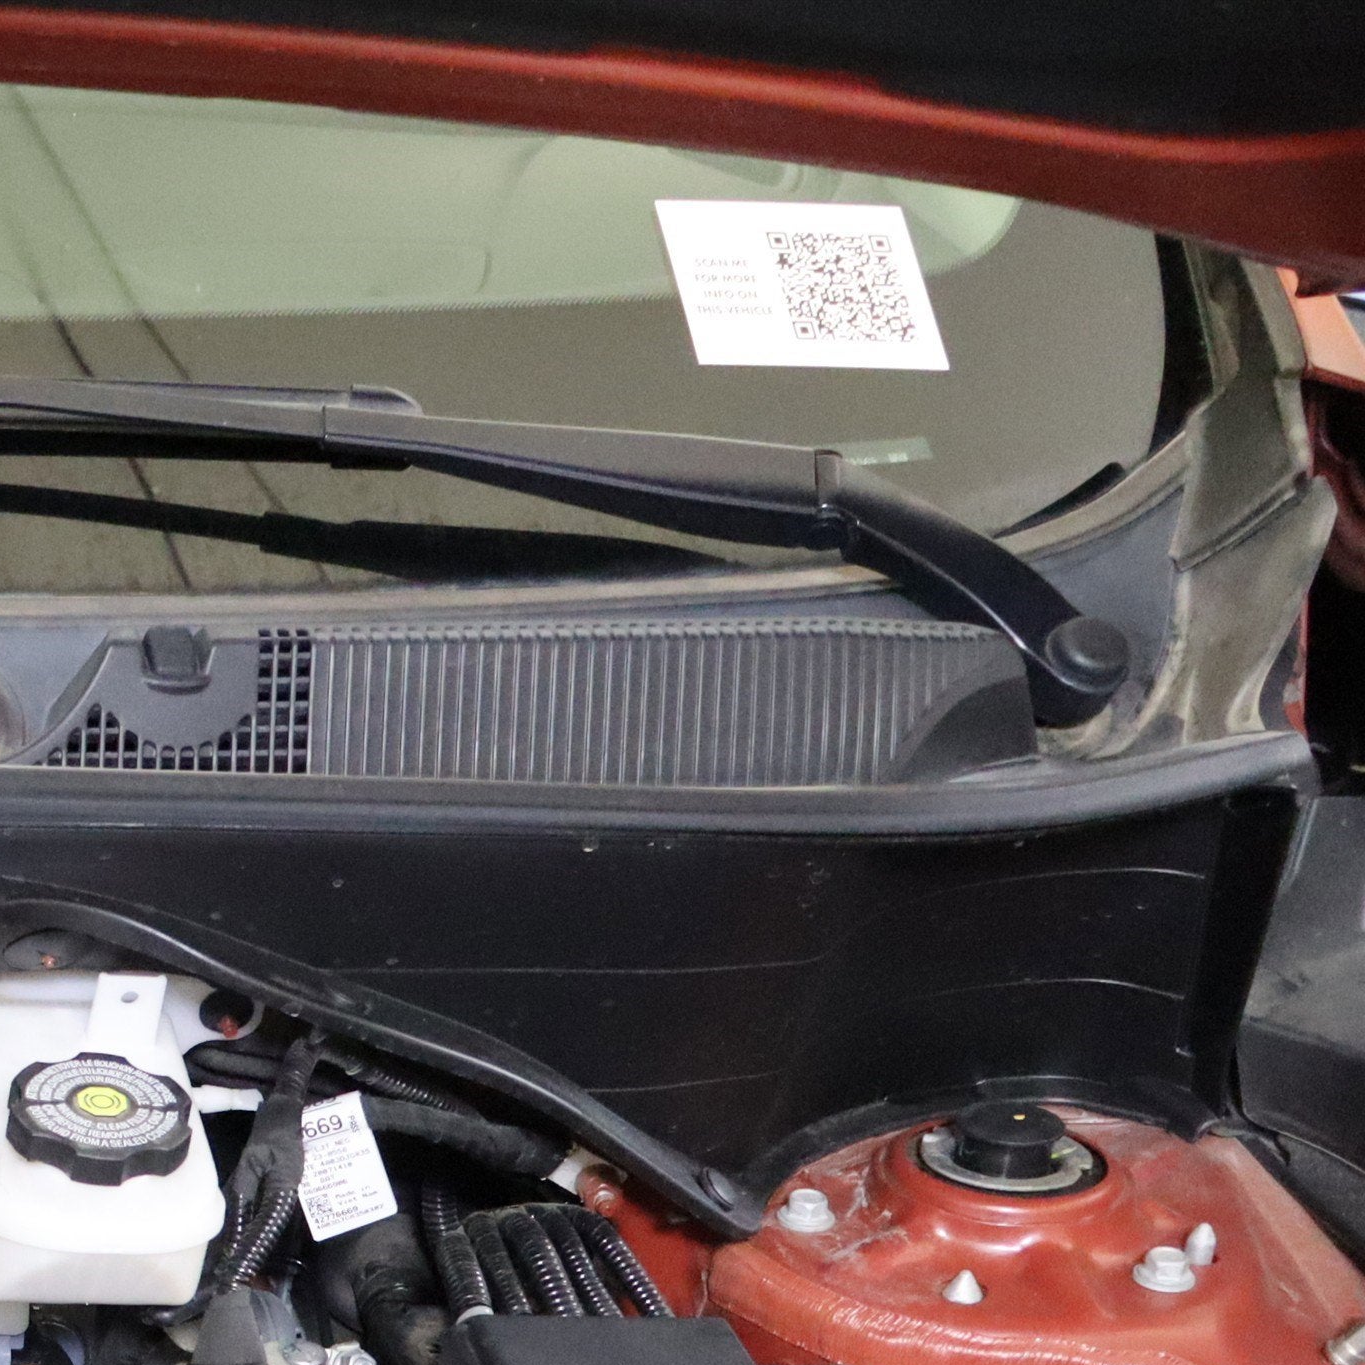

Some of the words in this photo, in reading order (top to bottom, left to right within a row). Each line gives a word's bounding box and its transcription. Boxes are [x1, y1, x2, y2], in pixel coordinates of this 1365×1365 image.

[695, 258, 728, 267] SCAN
[732, 259, 748, 267] ME
[695, 274, 717, 283] FOR
[723, 275, 756, 283] MORE
[703, 290, 734, 298] INFO
[697, 305, 722, 314] THIS
[727, 306, 773, 315] VEHICLE
[95, 1120, 130, 1130] CLEAN
[67, 1133, 99, 1144] FROM
[108, 1134, 149, 1148] SEALED
